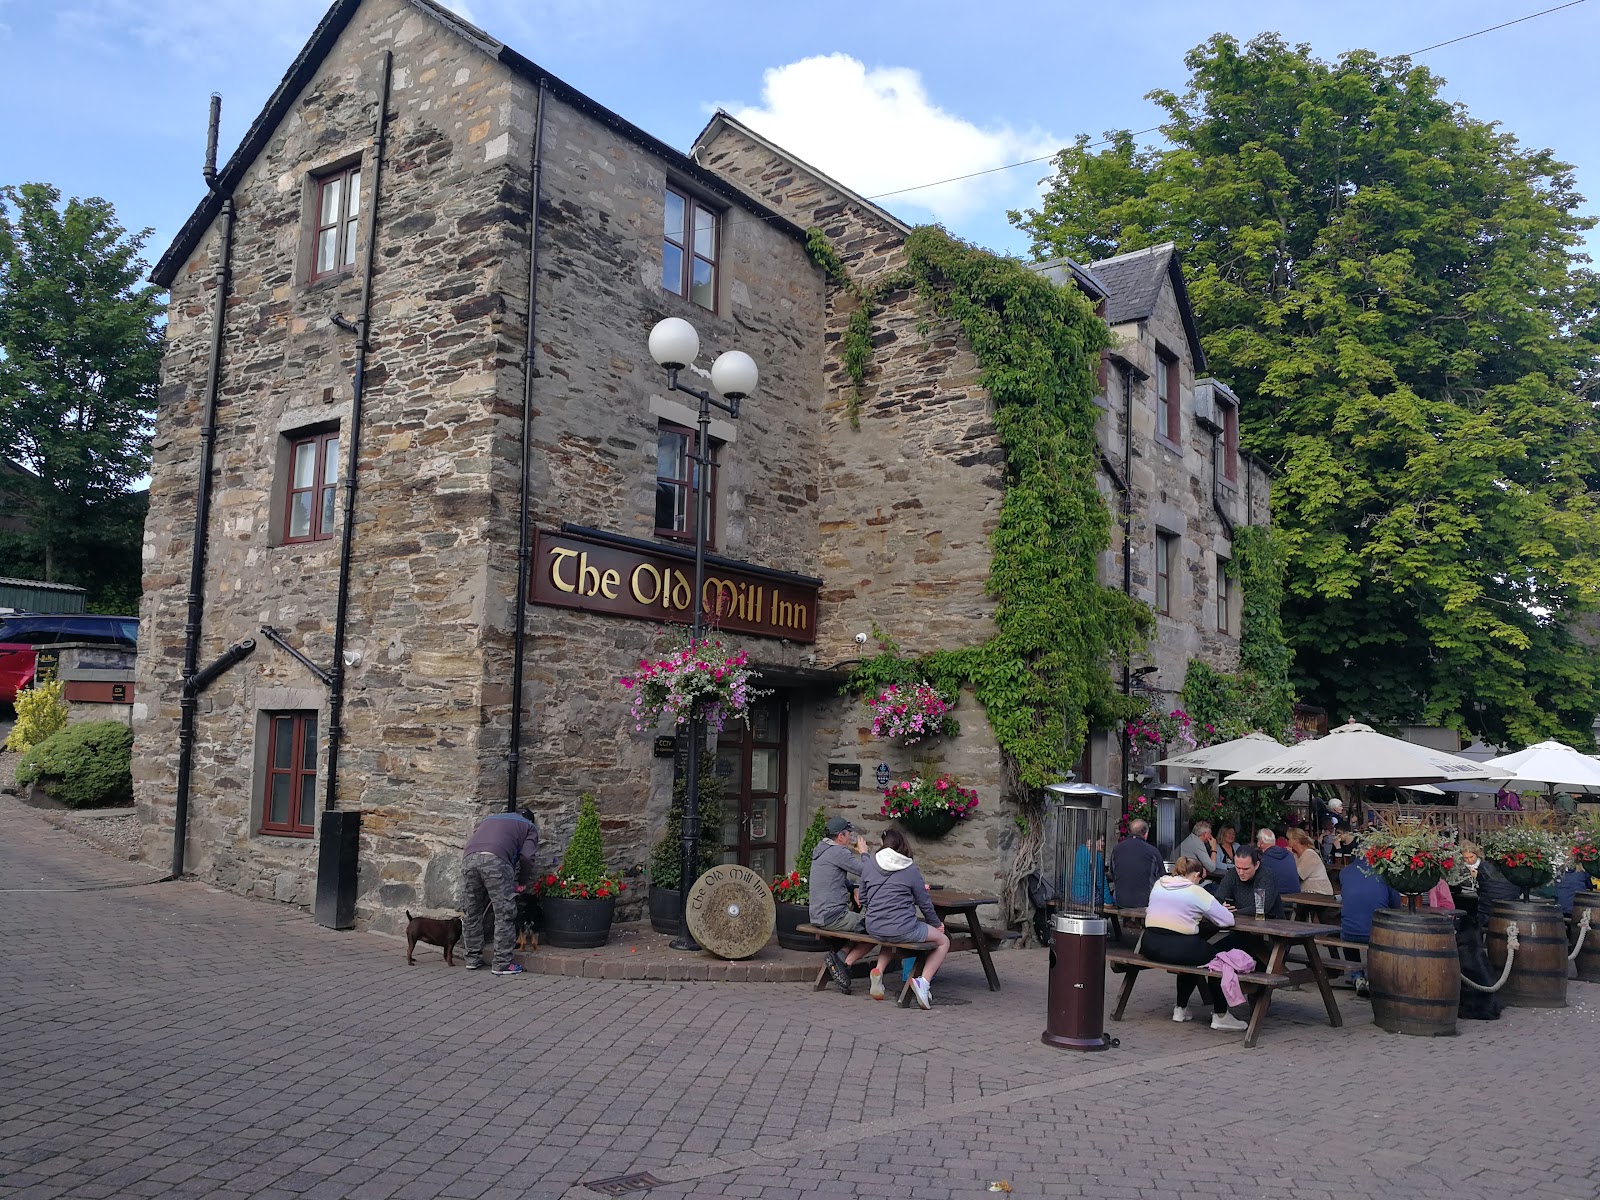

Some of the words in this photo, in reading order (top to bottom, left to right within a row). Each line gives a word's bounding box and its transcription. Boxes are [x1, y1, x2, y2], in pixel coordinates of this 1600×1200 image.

[550, 546, 621, 600] The
[631, 562, 692, 611] Old
[702, 576, 763, 623] Mill
[770, 588, 807, 630] Inn
[691, 887, 707, 910] The
[704, 870, 724, 886] Old
[729, 868, 754, 884] Mill
[753, 879, 767, 899] Inn
